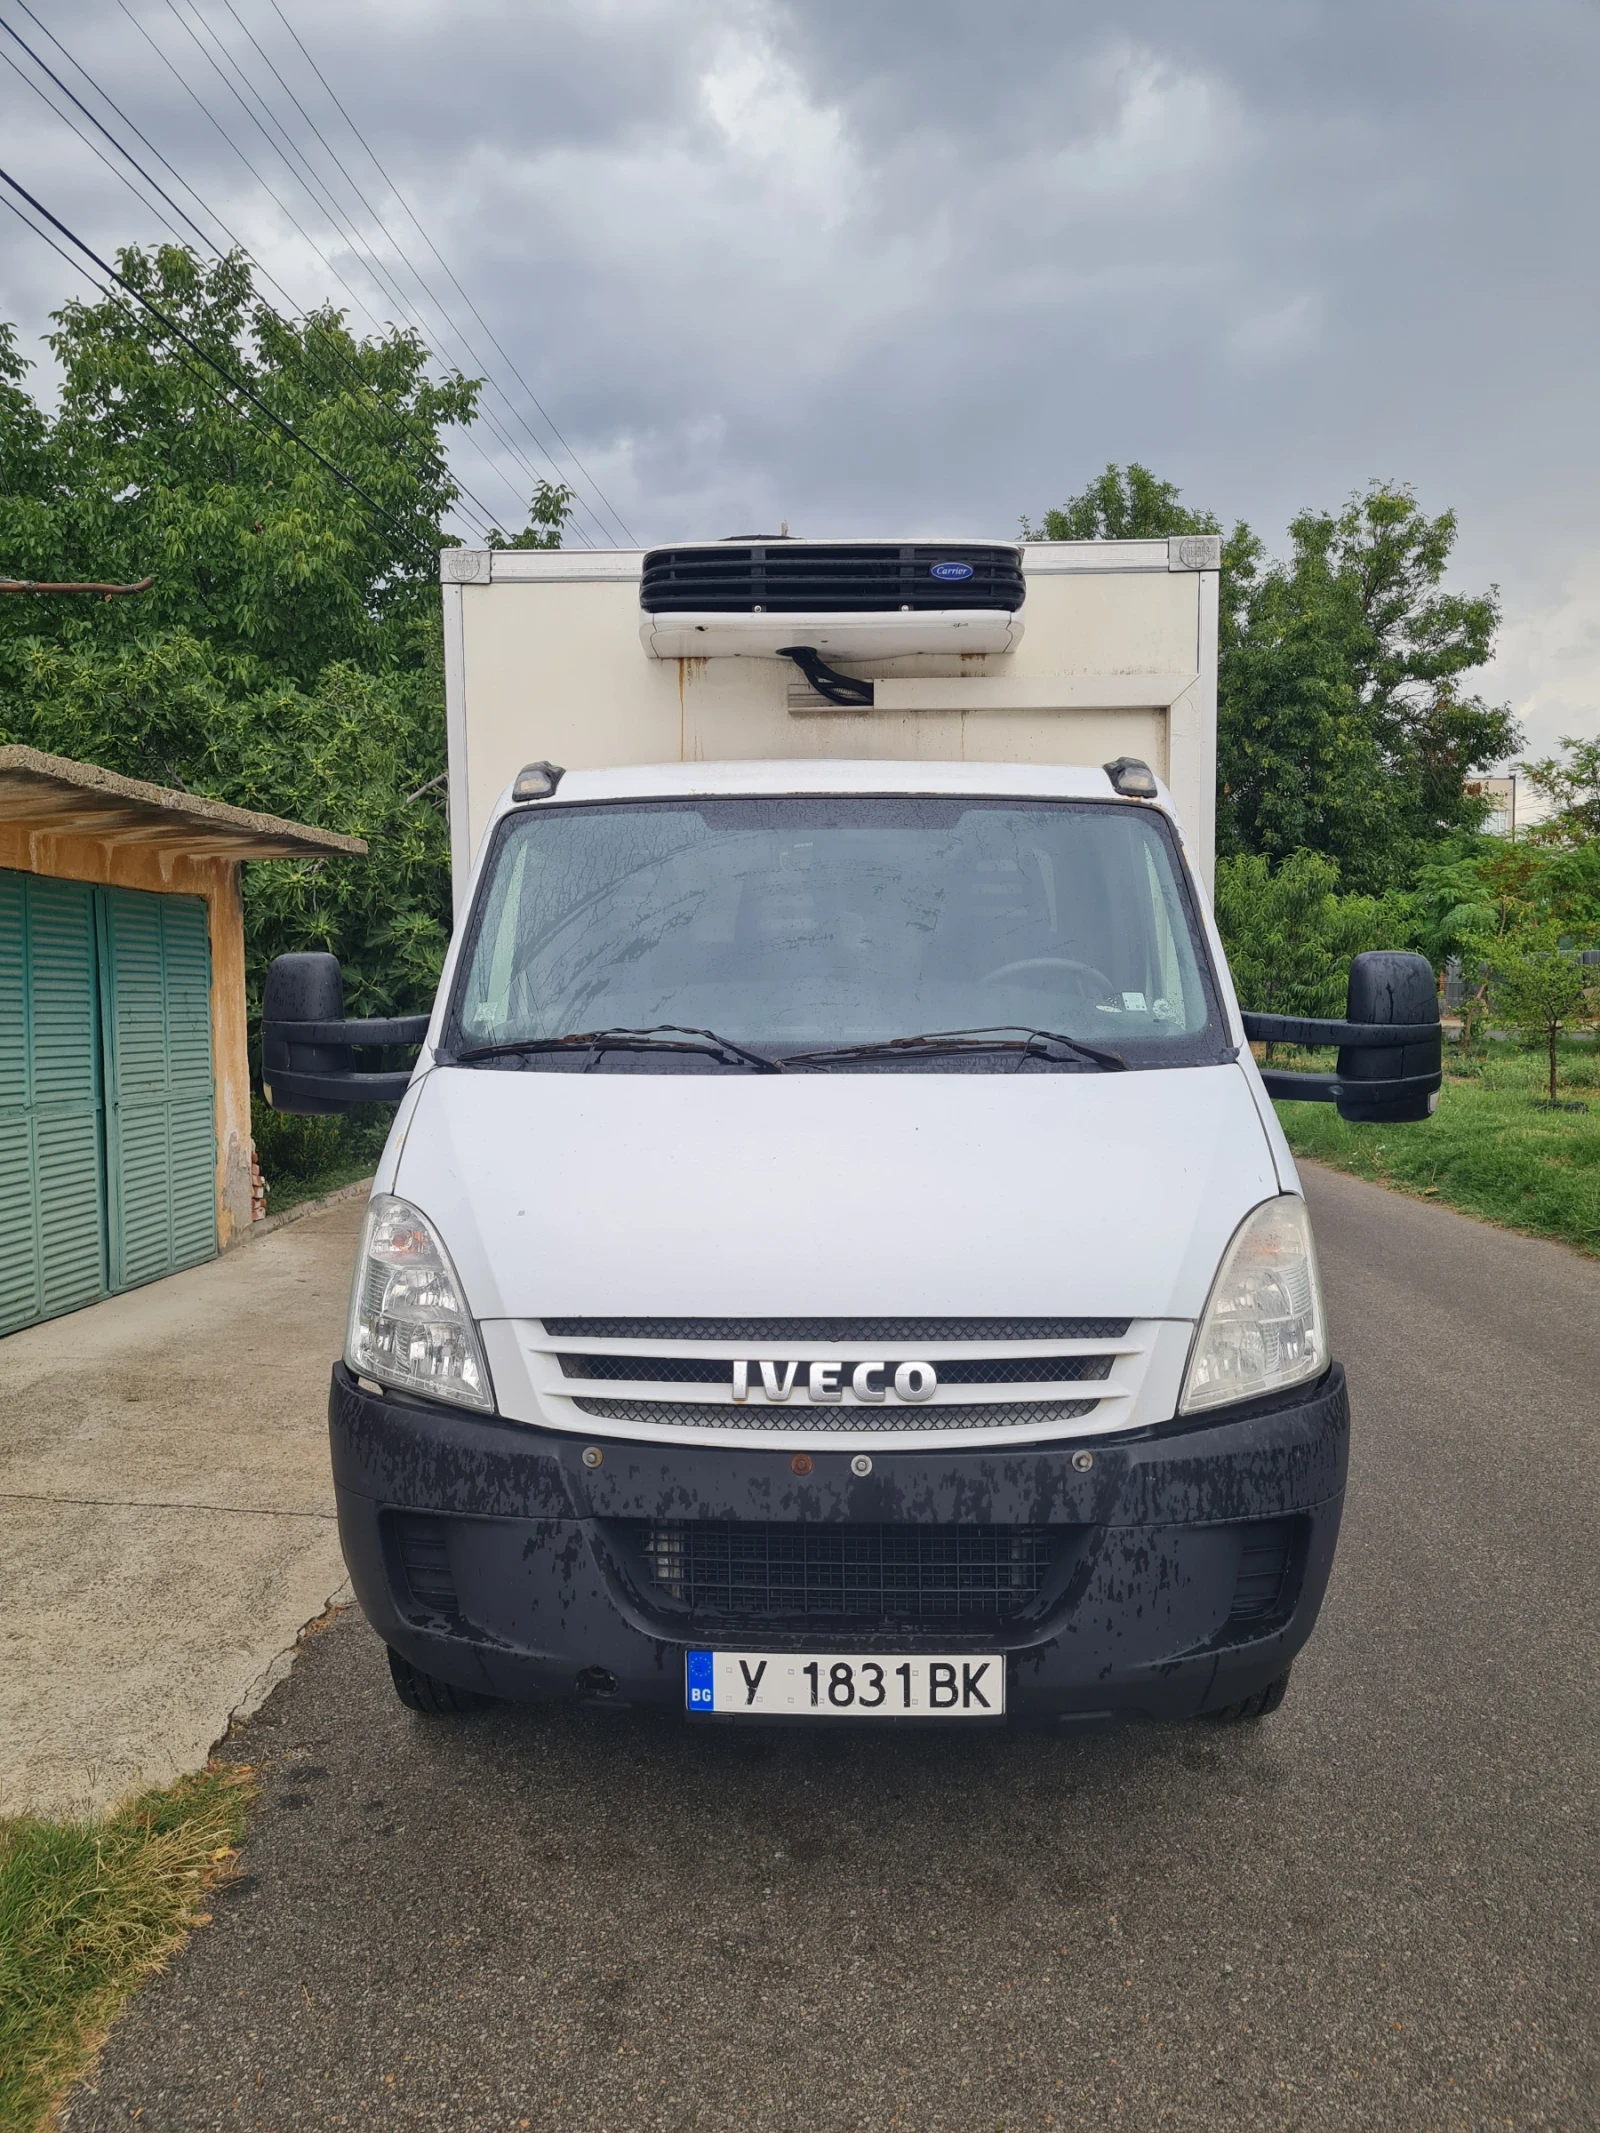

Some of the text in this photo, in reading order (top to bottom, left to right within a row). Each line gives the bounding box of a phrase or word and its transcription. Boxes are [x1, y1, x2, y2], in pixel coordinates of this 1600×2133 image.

[936, 566, 968, 575] Carrier
[732, 1361, 937, 1402] IVECO
[692, 1688, 711, 1702] BG
